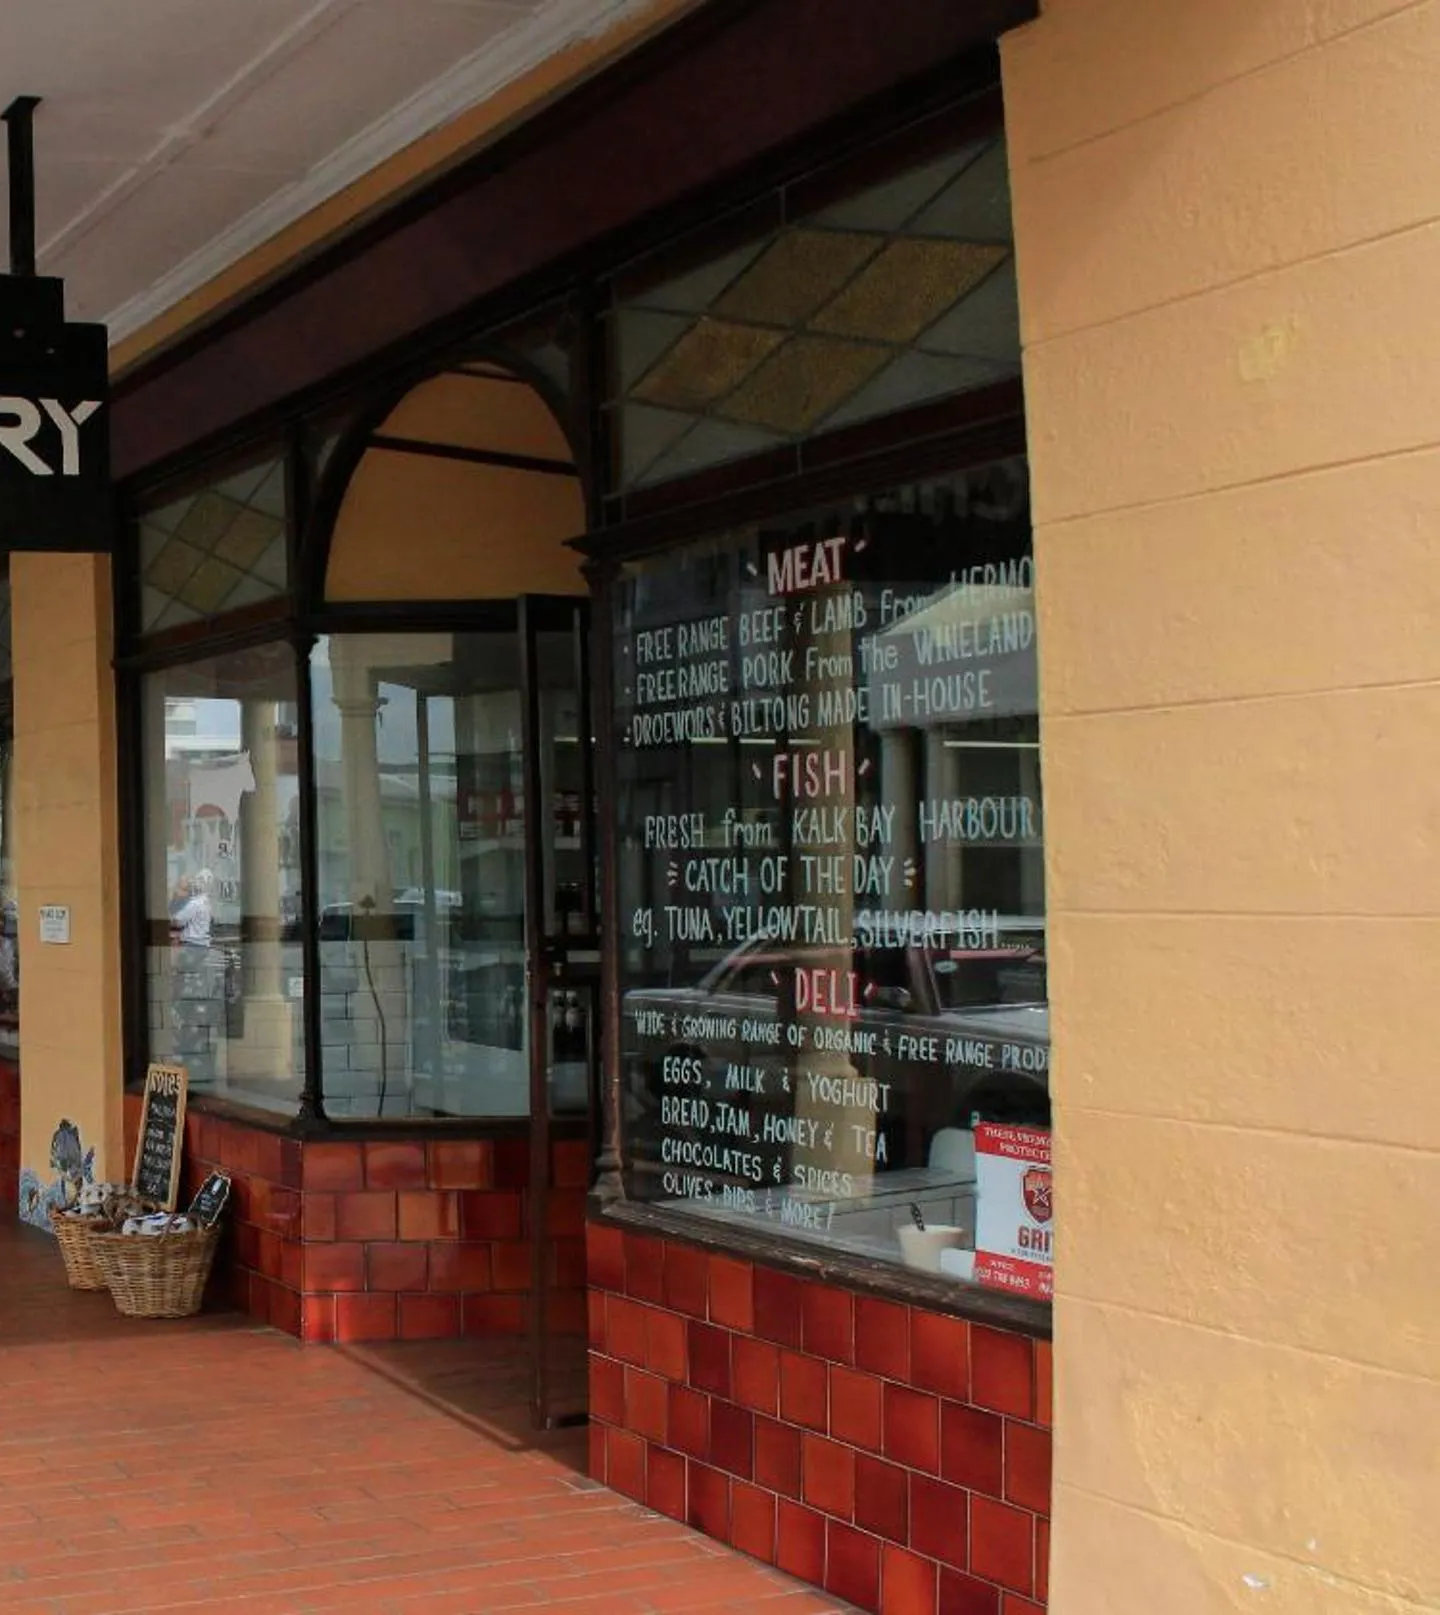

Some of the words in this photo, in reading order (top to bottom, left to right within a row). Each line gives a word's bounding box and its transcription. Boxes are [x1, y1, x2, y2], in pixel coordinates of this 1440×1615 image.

[767, 537, 846, 596] MEAT
[637, 627, 673, 664] FREE
[678, 616, 729, 658] RANGE
[739, 604, 786, 647] BEEF
[811, 592, 867, 636] LAMB
[637, 670, 676, 704] FREE
[678, 660, 729, 698] RANGE
[742, 651, 794, 690] PORK
[806, 648, 853, 681] From
[858, 634, 898, 673] the
[912, 611, 1033, 666] WINELAND
[633, 706, 715, 747] DROEWORS
[731, 694, 809, 736] BILTONG
[817, 687, 870, 727] MADE
[881, 671, 993, 721] IN-HOUSE
[773, 750, 847, 799] FISH
[644, 813, 705, 849] FRESH
[721, 808, 772, 848] from
[792, 807, 847, 846] KALK
[855, 805, 896, 849] BAY
[919, 796, 1037, 844] HARBOUR
[685, 857, 749, 894] CATCH
[760, 855, 788, 893] OF
[800, 855, 845, 896] THE
[853, 856, 895, 896] DAY
[794, 967, 858, 1018] DELI
[634, 1010, 665, 1037] WIDE
[682, 1015, 737, 1041] GROWING
[741, 1017, 781, 1045] RANGE
[787, 1026, 807, 1050] OF
[813, 1029, 877, 1057] ORGANIC
[898, 1035, 938, 1061] FREE
[945, 1038, 994, 1069] RANGE
[1001, 1044, 1049, 1072] PROD
[663, 1055, 711, 1088] EGGS,
[725, 1064, 765, 1093] MILK
[807, 1071, 891, 1113] YOGHURT
[764, 1113, 818, 1150] HONEY
[852, 1123, 888, 1162] TEA
[662, 1138, 761, 1182] CHOCOLATES
[794, 1165, 852, 1198] SPICES
[1018, 1225, 1052, 1253] GRI
